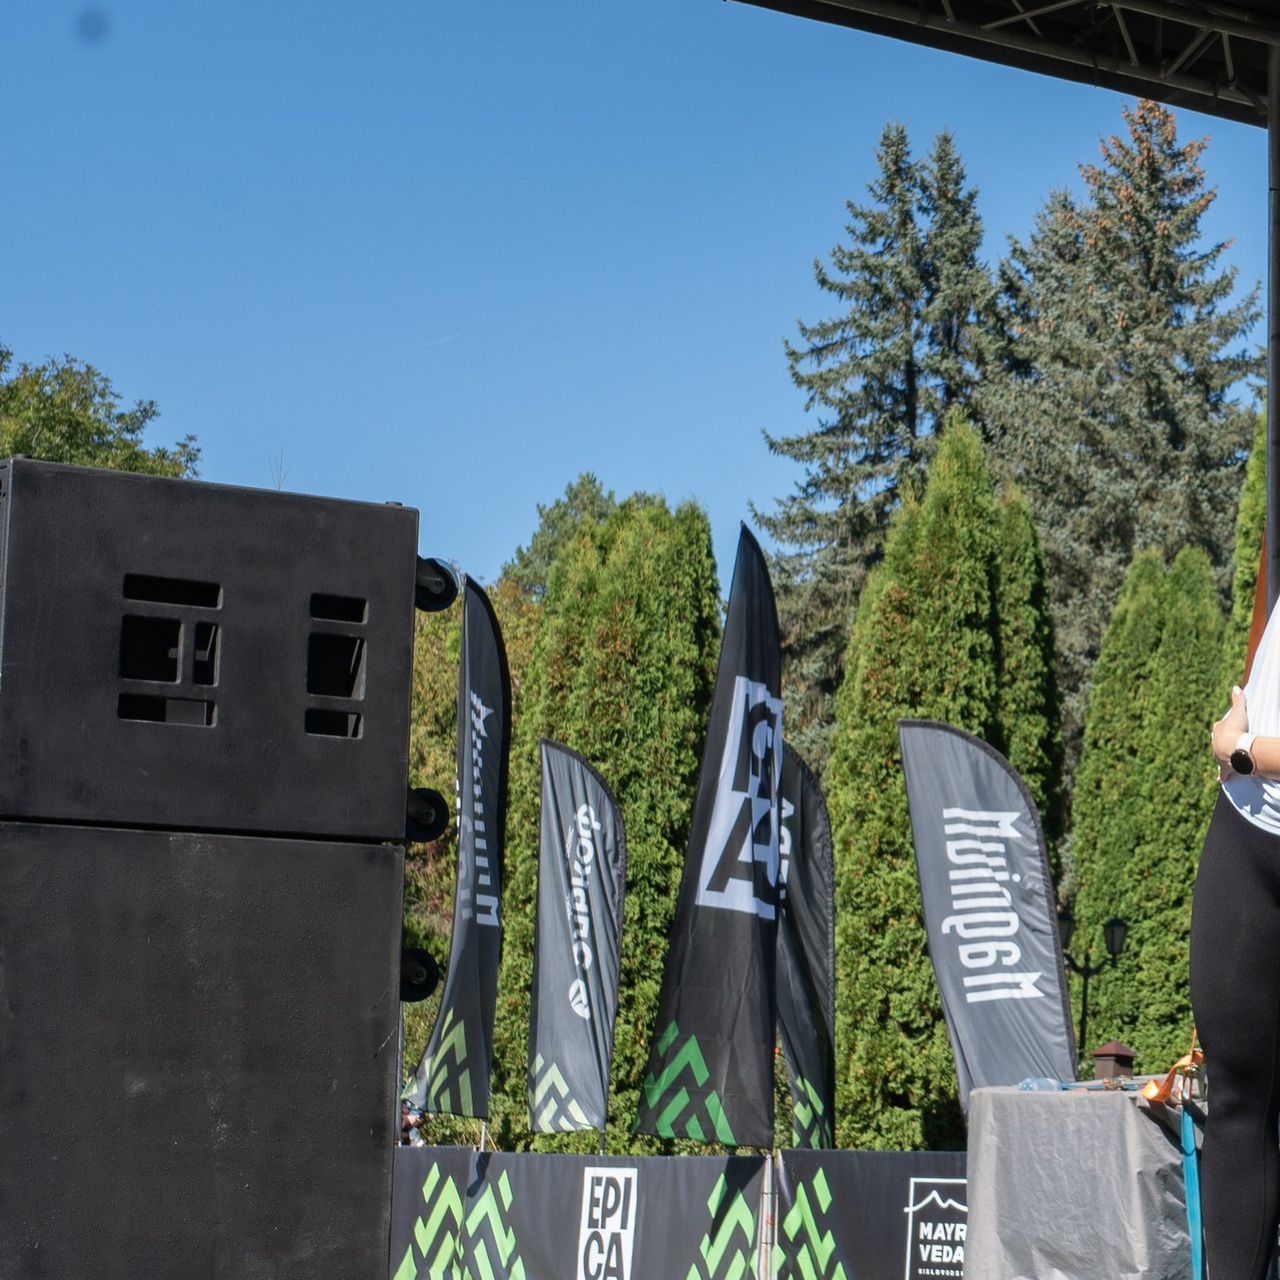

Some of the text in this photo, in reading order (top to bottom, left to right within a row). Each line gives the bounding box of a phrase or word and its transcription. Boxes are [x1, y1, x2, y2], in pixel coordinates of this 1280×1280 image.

[587, 1176, 633, 1230] EPI
[919, 1222, 967, 1241] MAYR
[919, 1244, 965, 1263] VEDA
